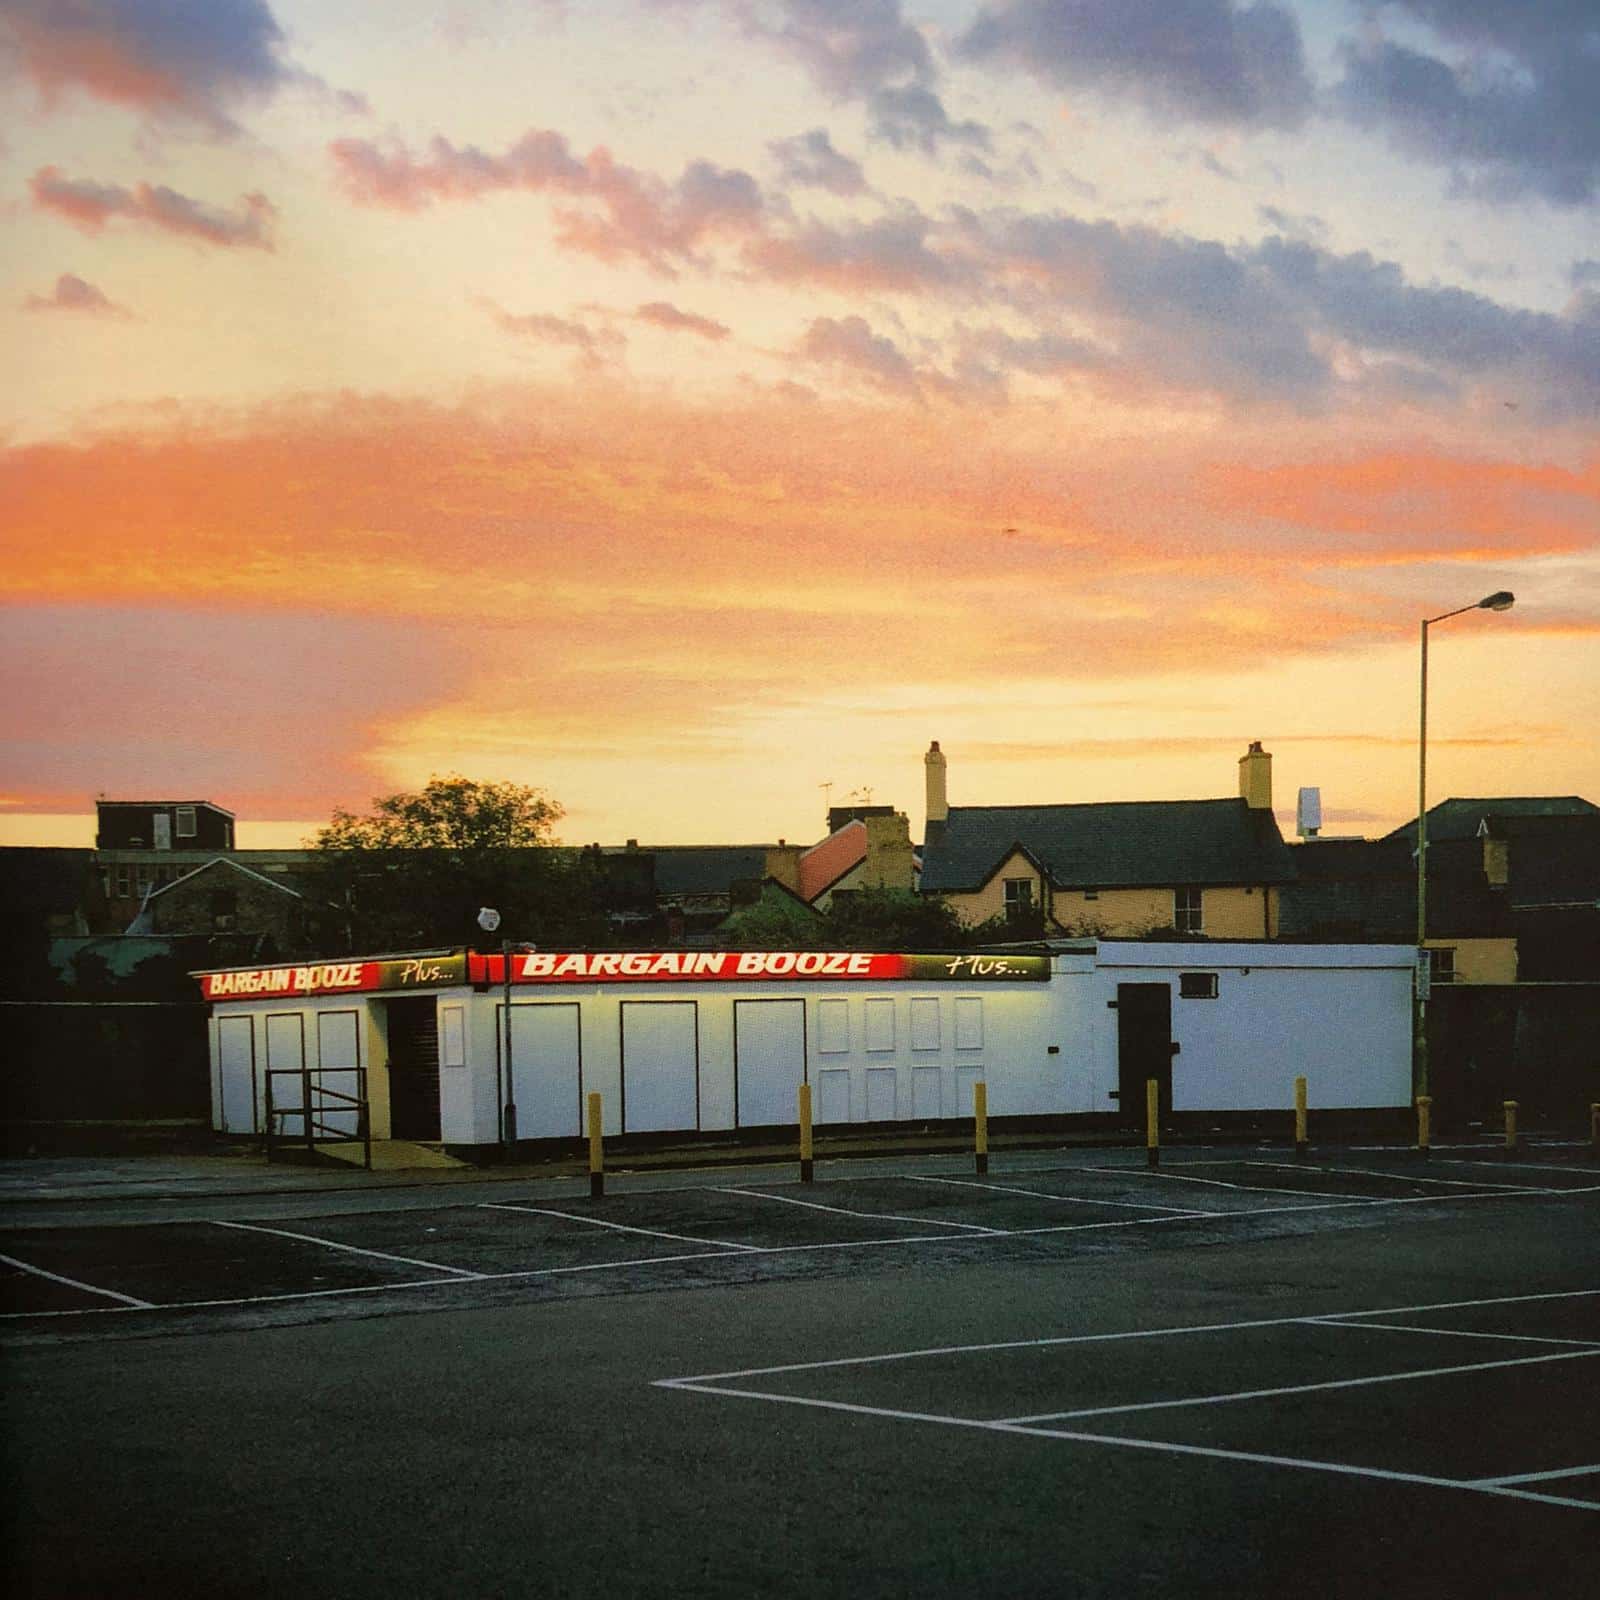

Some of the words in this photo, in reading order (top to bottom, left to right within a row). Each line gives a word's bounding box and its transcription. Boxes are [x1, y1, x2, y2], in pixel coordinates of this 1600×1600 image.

[522, 952, 726, 976] BARGAIN
[736, 952, 874, 975] BOOZE
[210, 968, 289, 995] BARGAIN
[295, 963, 362, 990] BOOZE
